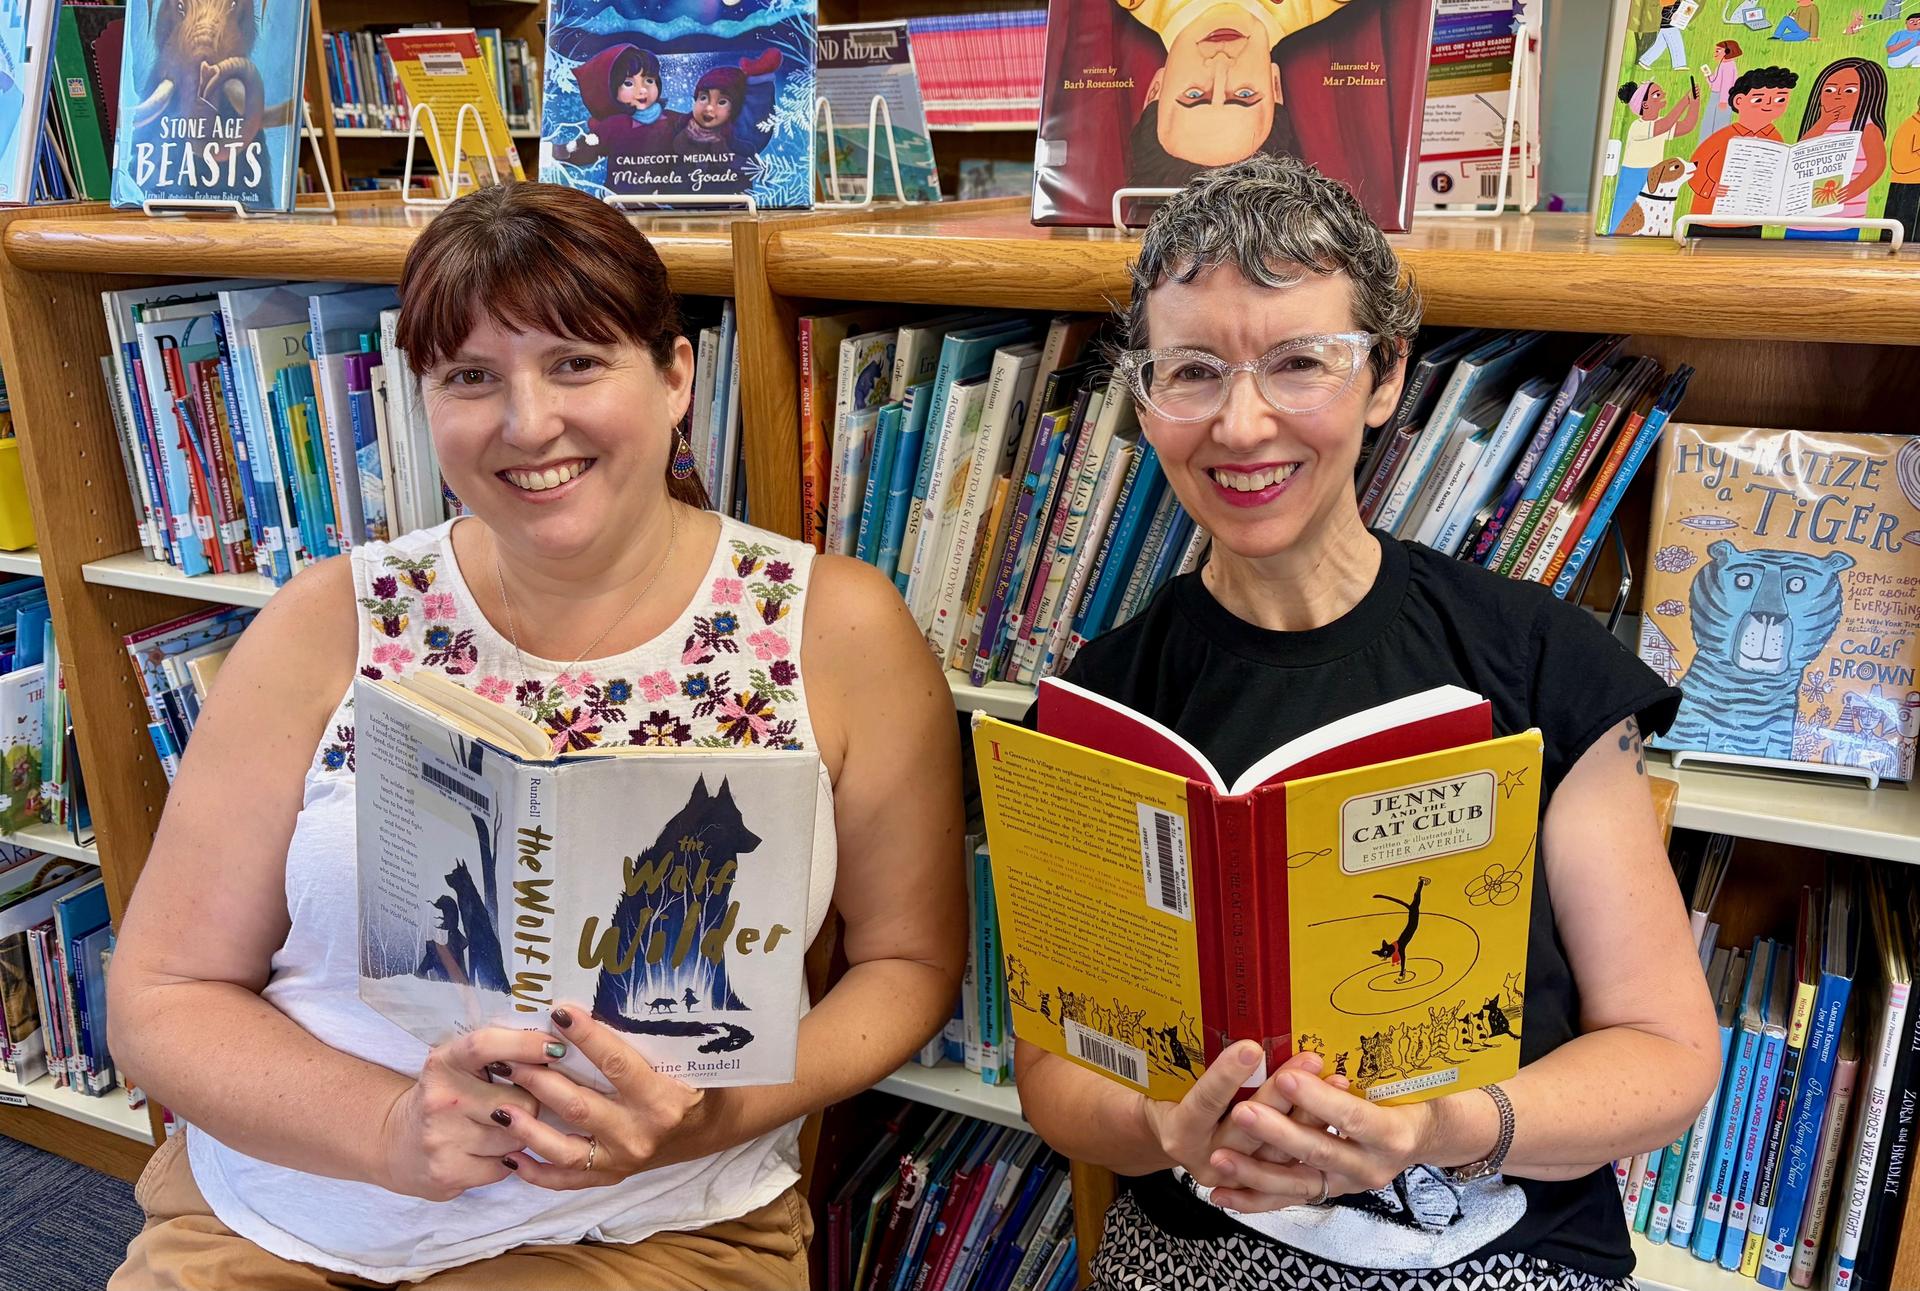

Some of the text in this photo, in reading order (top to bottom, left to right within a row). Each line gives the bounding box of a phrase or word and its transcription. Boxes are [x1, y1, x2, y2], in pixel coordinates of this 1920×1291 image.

[1109, 66, 1118, 76] by
[1323, 75, 1386, 86] Mar Delmar
[1330, 62, 1380, 72] illustrated by
[1064, 77, 1134, 89] Barb Rosenstock
[160, 115, 244, 139] STONE AGE
[136, 141, 262, 187] BEASTS
[617, 153, 736, 165] CALDECOTT MEDALIST
[1793, 153, 1847, 170] OCTOPUS ON
[1796, 162, 1842, 179] THE LOOSE
[612, 169, 738, 191] Michaela Goade
[894, 357, 905, 382] Carle
[936, 363, 949, 391] Tomie
[220, 360, 241, 435] ANIMAL NEIGHBORS
[987, 365, 1004, 410] Schulman
[1396, 377, 1423, 422] JEFFERS
[200, 379, 222, 461] ANIMAL WONDERS
[979, 422, 991, 446] YOU
[1039, 427, 1049, 447] BROWN
[1483, 405, 1521, 468] Kooser Wanek Jones
[1563, 427, 1586, 462] ANIMALS
[1614, 422, 1636, 456] LEVINSON
[920, 440, 934, 474] BOOK
[972, 446, 986, 476] READ
[1556, 462, 1566, 474] AT
[1612, 421, 1656, 491] Livingston Fisher
[917, 476, 927, 490] OF
[968, 477, 979, 492] TO
[1073, 450, 1100, 508] ANIMALS
[1434, 460, 1465, 513] Janeczko Raschka
[1547, 473, 1560, 490] THE
[219, 476, 234, 520] WONDERS
[964, 491, 976, 509] ME
[1717, 486, 1733, 502] a
[908, 495, 923, 534] POEMS
[962, 508, 972, 518] &
[1531, 506, 1541, 519] ON
[1543, 503, 1558, 524] THE
[1076, 444, 1144, 619] FIREFLY JULY A Year of Very Short Poems
[1521, 517, 1535, 536] THE
[952, 536, 966, 564] READ
[1508, 534, 1526, 559] LOOSE
[1522, 520, 1548, 561] MISTAKES
[1538, 526, 1562, 561] LEWIS
[1565, 534, 1592, 572] SKY
[995, 510, 1027, 600] Flamingos on the Roof
[1499, 558, 1512, 575] TOO
[948, 565, 959, 581] TO
[943, 581, 956, 603] YOU
[1828, 657, 1916, 686] BROWN
[1372, 781, 1467, 816] JENNY
[1390, 802, 1447, 819] AND THE
[1353, 805, 1483, 843] CAT CLUB
[677, 835, 704, 852] the
[1363, 833, 1473, 863] ESTHER AVERILL
[1373, 841, 1401, 850] written
[1413, 828, 1453, 843] illustrated
[1455, 827, 1465, 835] by
[513, 777, 554, 964] Rundell the Wolf
[622, 850, 738, 896] Wolf
[577, 900, 792, 974] Wilder
[1796, 996, 1808, 1018] Hirsch
[1816, 1007, 1827, 1022] JON
[1810, 1028, 1822, 1049] MUTH
[1818, 999, 1841, 1063] CAROLINE KENNEDY
[687, 1058, 740, 1072] Rundell
[1735, 1064, 1748, 1094] SCHOOL
[1730, 1093, 1742, 1116] JOKES
[1723, 1121, 1736, 1150] RIDDLES
[1770, 1119, 1783, 1140] Poems
[1785, 1076, 1824, 1188] Poems to Learn by Heart
[1829, 1126, 1841, 1153] SHEPARD
[1883, 1089, 1916, 1197] ZORN and BRADLEY
[1768, 1139, 1779, 1151] for
[1762, 1150, 1777, 1181] Intelligent
[1845, 1086, 1885, 1238] HIS SHOES WERE FAR TOO TIGHT
[1757, 1180, 1770, 1206] Children
[1807, 1157, 1834, 1240] When We Were Very Young
